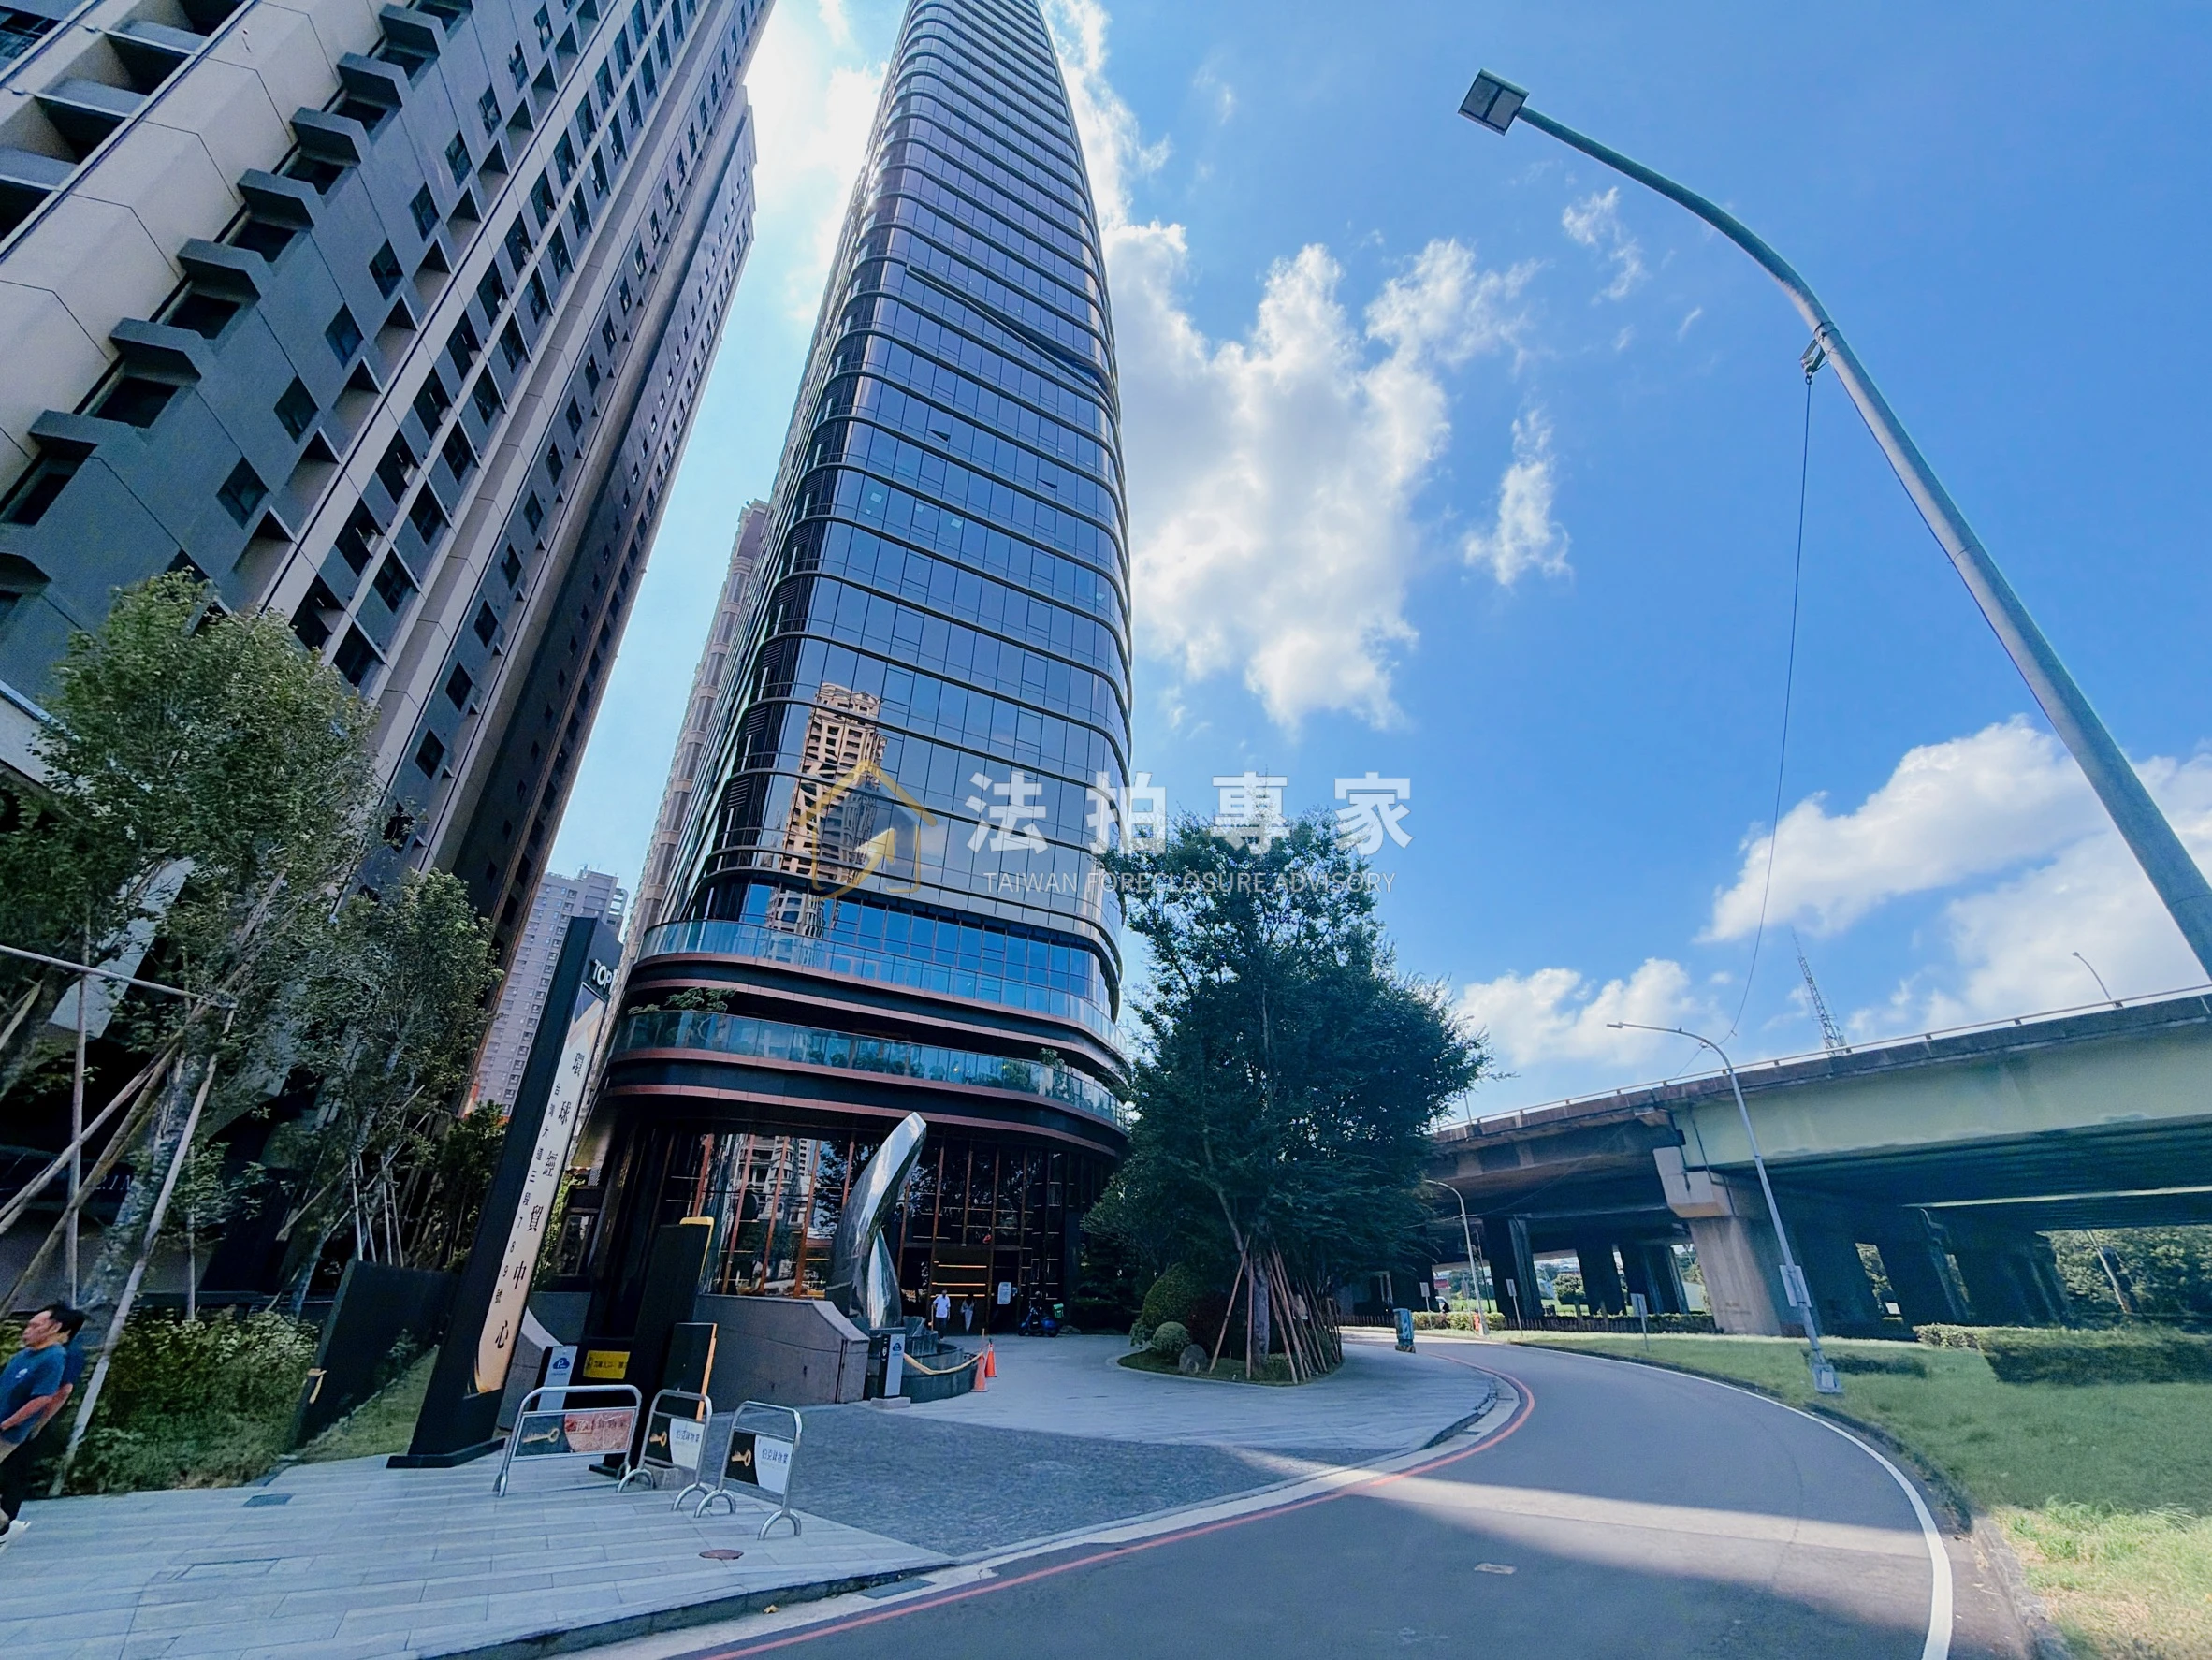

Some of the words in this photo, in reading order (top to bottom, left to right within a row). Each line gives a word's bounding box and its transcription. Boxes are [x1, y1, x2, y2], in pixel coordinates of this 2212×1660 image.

[495, 1052, 585, 1349] 環球經貿中心
